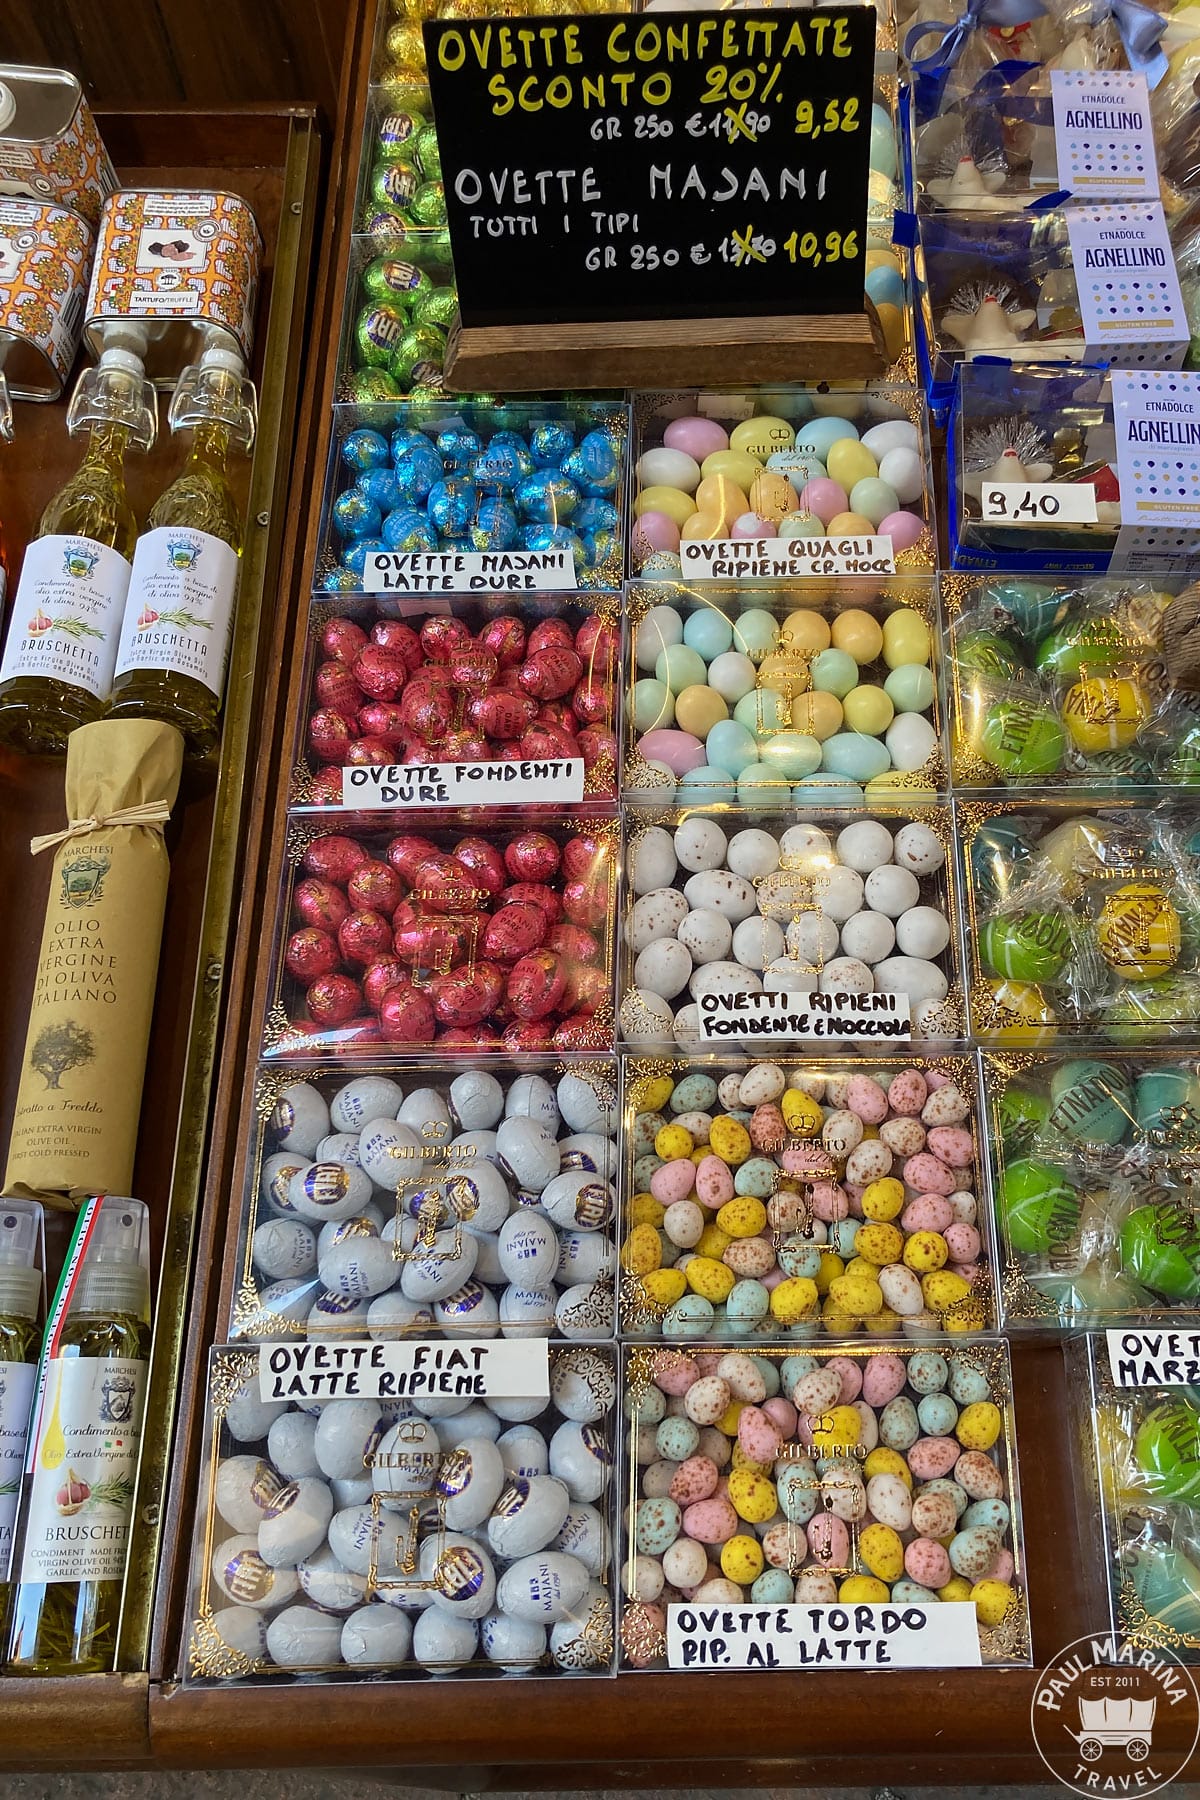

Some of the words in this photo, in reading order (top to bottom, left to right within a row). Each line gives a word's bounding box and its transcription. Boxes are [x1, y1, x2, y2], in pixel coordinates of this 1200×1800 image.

[438, 24, 583, 71] OVETTE
[607, 18, 853, 63] CONFETTATE
[488, 72, 672, 116] SCONTO
[700, 62, 784, 104] 20%
[1082, 95, 1126, 104] ETNADOLCE
[590, 117, 622, 140] GR
[634, 114, 674, 139] 250
[795, 97, 860, 140] 9,52
[1066, 110, 1143, 130] AGNELLINO
[454, 167, 601, 205] OVETTE
[650, 163, 828, 202] MAJANI
[564, 214, 570, 234] I
[591, 212, 639, 235] TIPI
[1099, 231, 1146, 240] ETNADOLCE
[585, 246, 617, 271] GR
[630, 244, 680, 271] 250
[783, 230, 859, 268] 10,96
[1085, 247, 1166, 268] AGNELLINO
[1146, 402, 1194, 413] ETNADOLCE
[746, 444, 816, 455] GILBERTO
[988, 491, 1060, 517] 9,40
[66, 539, 103, 553] MARCHESI
[168, 532, 206, 544] MARCHESI
[685, 540, 768, 560] OVETTE
[787, 538, 873, 559] QUAGLI
[374, 554, 466, 572] OVETTE
[712, 559, 801, 578] RIPIENE
[383, 572, 455, 591] LATTE
[469, 573, 537, 590] DURE
[53, 589, 75, 597] extra
[79, 593, 107, 609] vergine
[54, 597, 75, 606] oliva
[183, 585, 213, 600] vergine
[21, 639, 99, 667] BRUSCHETTA
[131, 633, 207, 656] BRUSCHETTA
[149, 648, 171, 656] Virgin
[174, 650, 191, 661] Olive
[41, 655, 63, 665] Virgin
[66, 660, 84, 671] Olive
[137, 654, 158, 662] Garlic
[177, 658, 208, 678] Rosemary
[28, 661, 50, 669] Garlic
[53, 665, 66, 673] and
[69, 668, 99, 689] Rosemary
[350, 764, 443, 788] OVETTE
[455, 762, 573, 784] FONDENTI
[380, 783, 450, 803] DURE
[63, 845, 114, 858] MARCHESI
[54, 919, 100, 935] OLIO
[49, 936, 105, 953] EXTRA
[40, 953, 118, 973] VERGINE
[37, 976, 49, 991] DI
[55, 971, 115, 986] OLIVA
[701, 992, 788, 1012] OVETTI
[808, 992, 896, 1013] RIPIENI
[703, 1014, 810, 1037] FONDENTE
[60, 1099, 103, 1114] Freddo
[344, 1091, 361, 1128] MAJANI
[37, 1125, 64, 1133] EXTRA
[67, 1125, 102, 1135] VIRGIN
[27, 1137, 51, 1146] OLIVE
[365, 1135, 398, 1166] MAJANI
[761, 1137, 848, 1153] GILBERTO
[29, 1150, 51, 1158] COLD
[54, 1150, 90, 1158] PRESSED
[389, 1144, 478, 1160] GILBERTO
[77, 1206, 94, 1247] OLIO
[507, 1238, 547, 1252] MAJANI
[64, 1255, 79, 1289] CON
[515, 1291, 555, 1304] MAJANI
[39, 1297, 65, 1395] PRODOTTO
[269, 1345, 387, 1374] OVETTE
[413, 1346, 490, 1371] FIAT
[104, 1367, 137, 1375] MARCHESI
[273, 1372, 360, 1397] LATTE
[378, 1372, 487, 1396] RIPIENE
[63, 1424, 122, 1437] Condimento
[66, 1449, 92, 1458] Extra
[94, 1448, 126, 1462] Vergine
[775, 1442, 868, 1459] GILBERTO
[558, 1513, 590, 1552] MAJANI
[31, 1549, 85, 1558] CONDIMENT
[38, 1559, 70, 1567] VIRGIN
[71, 1558, 97, 1566] OLIVE
[98, 1557, 111, 1565] OIL
[46, 1568, 79, 1577] GARLIC
[81, 1567, 101, 1575] AND
[543, 1564, 552, 1611] MAJANI
[677, 1608, 793, 1633] OVETTE
[808, 1606, 928, 1633] TORDO
[682, 1639, 731, 1666] RIP.
[747, 1640, 780, 1667] AL
[799, 1638, 892, 1663] LATTE
